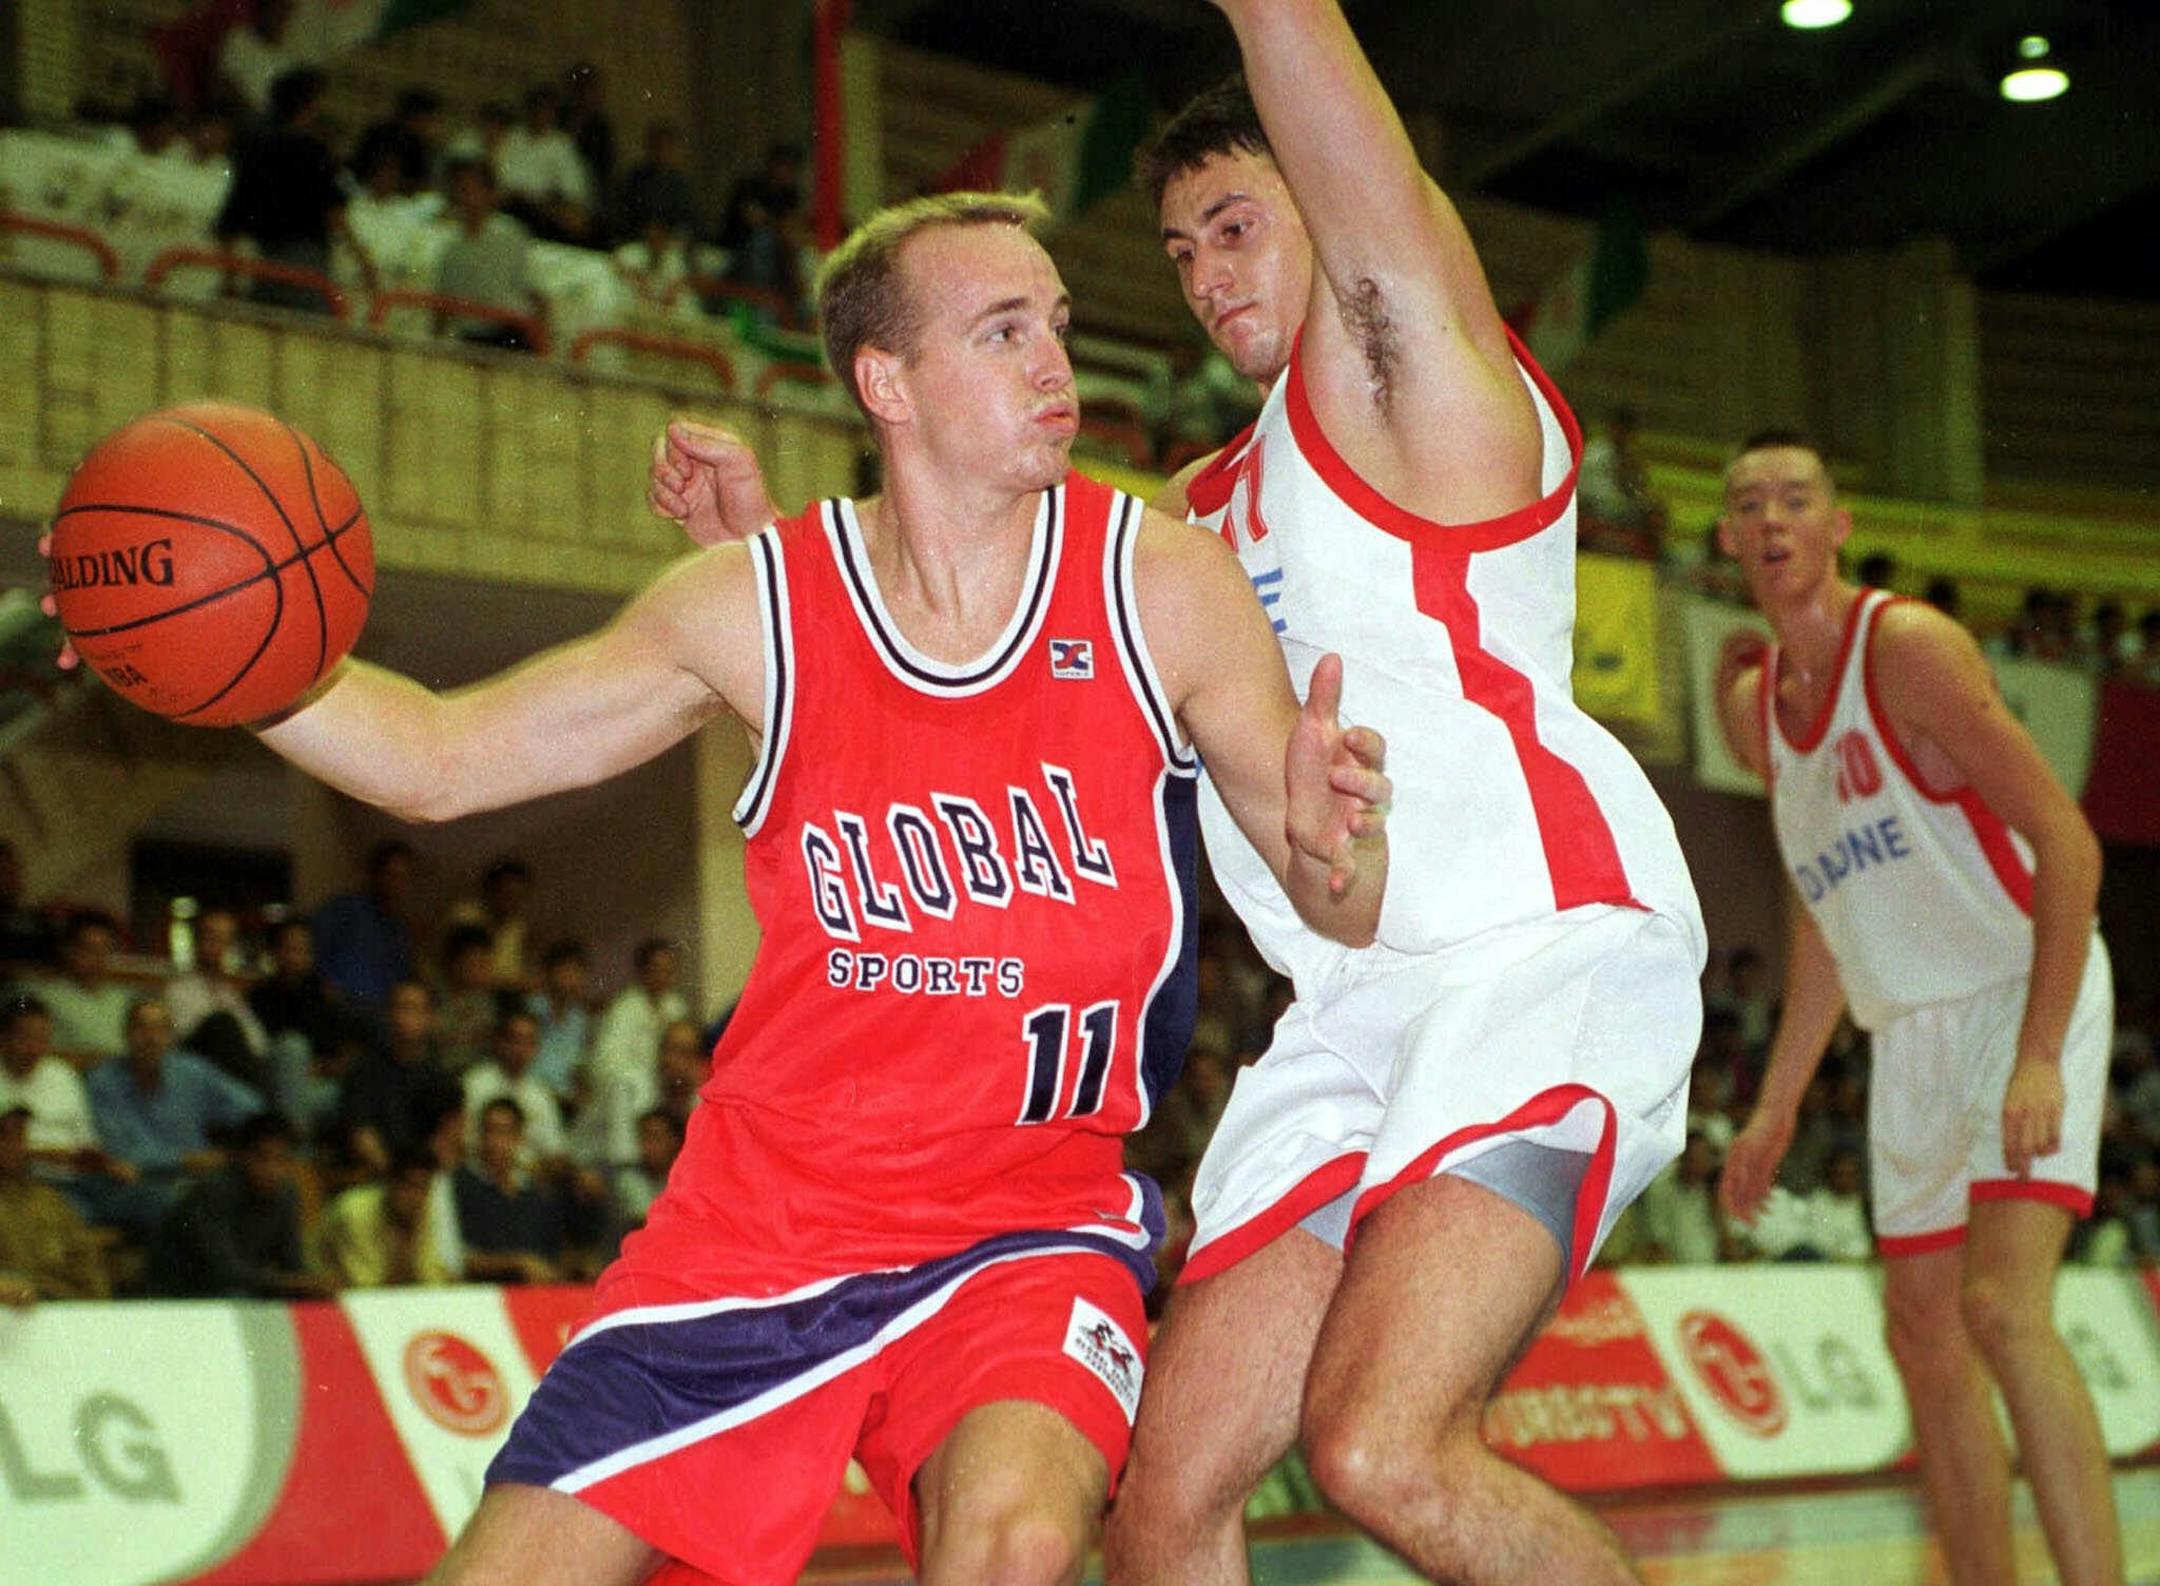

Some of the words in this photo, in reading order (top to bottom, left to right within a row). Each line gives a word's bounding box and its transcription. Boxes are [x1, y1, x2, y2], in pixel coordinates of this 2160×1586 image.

[801, 761, 1119, 942] GLOBAL
[828, 948, 1025, 997] SPORTS
[1014, 1000, 1120, 1127] 11
[0, 1388, 184, 1502] LG
